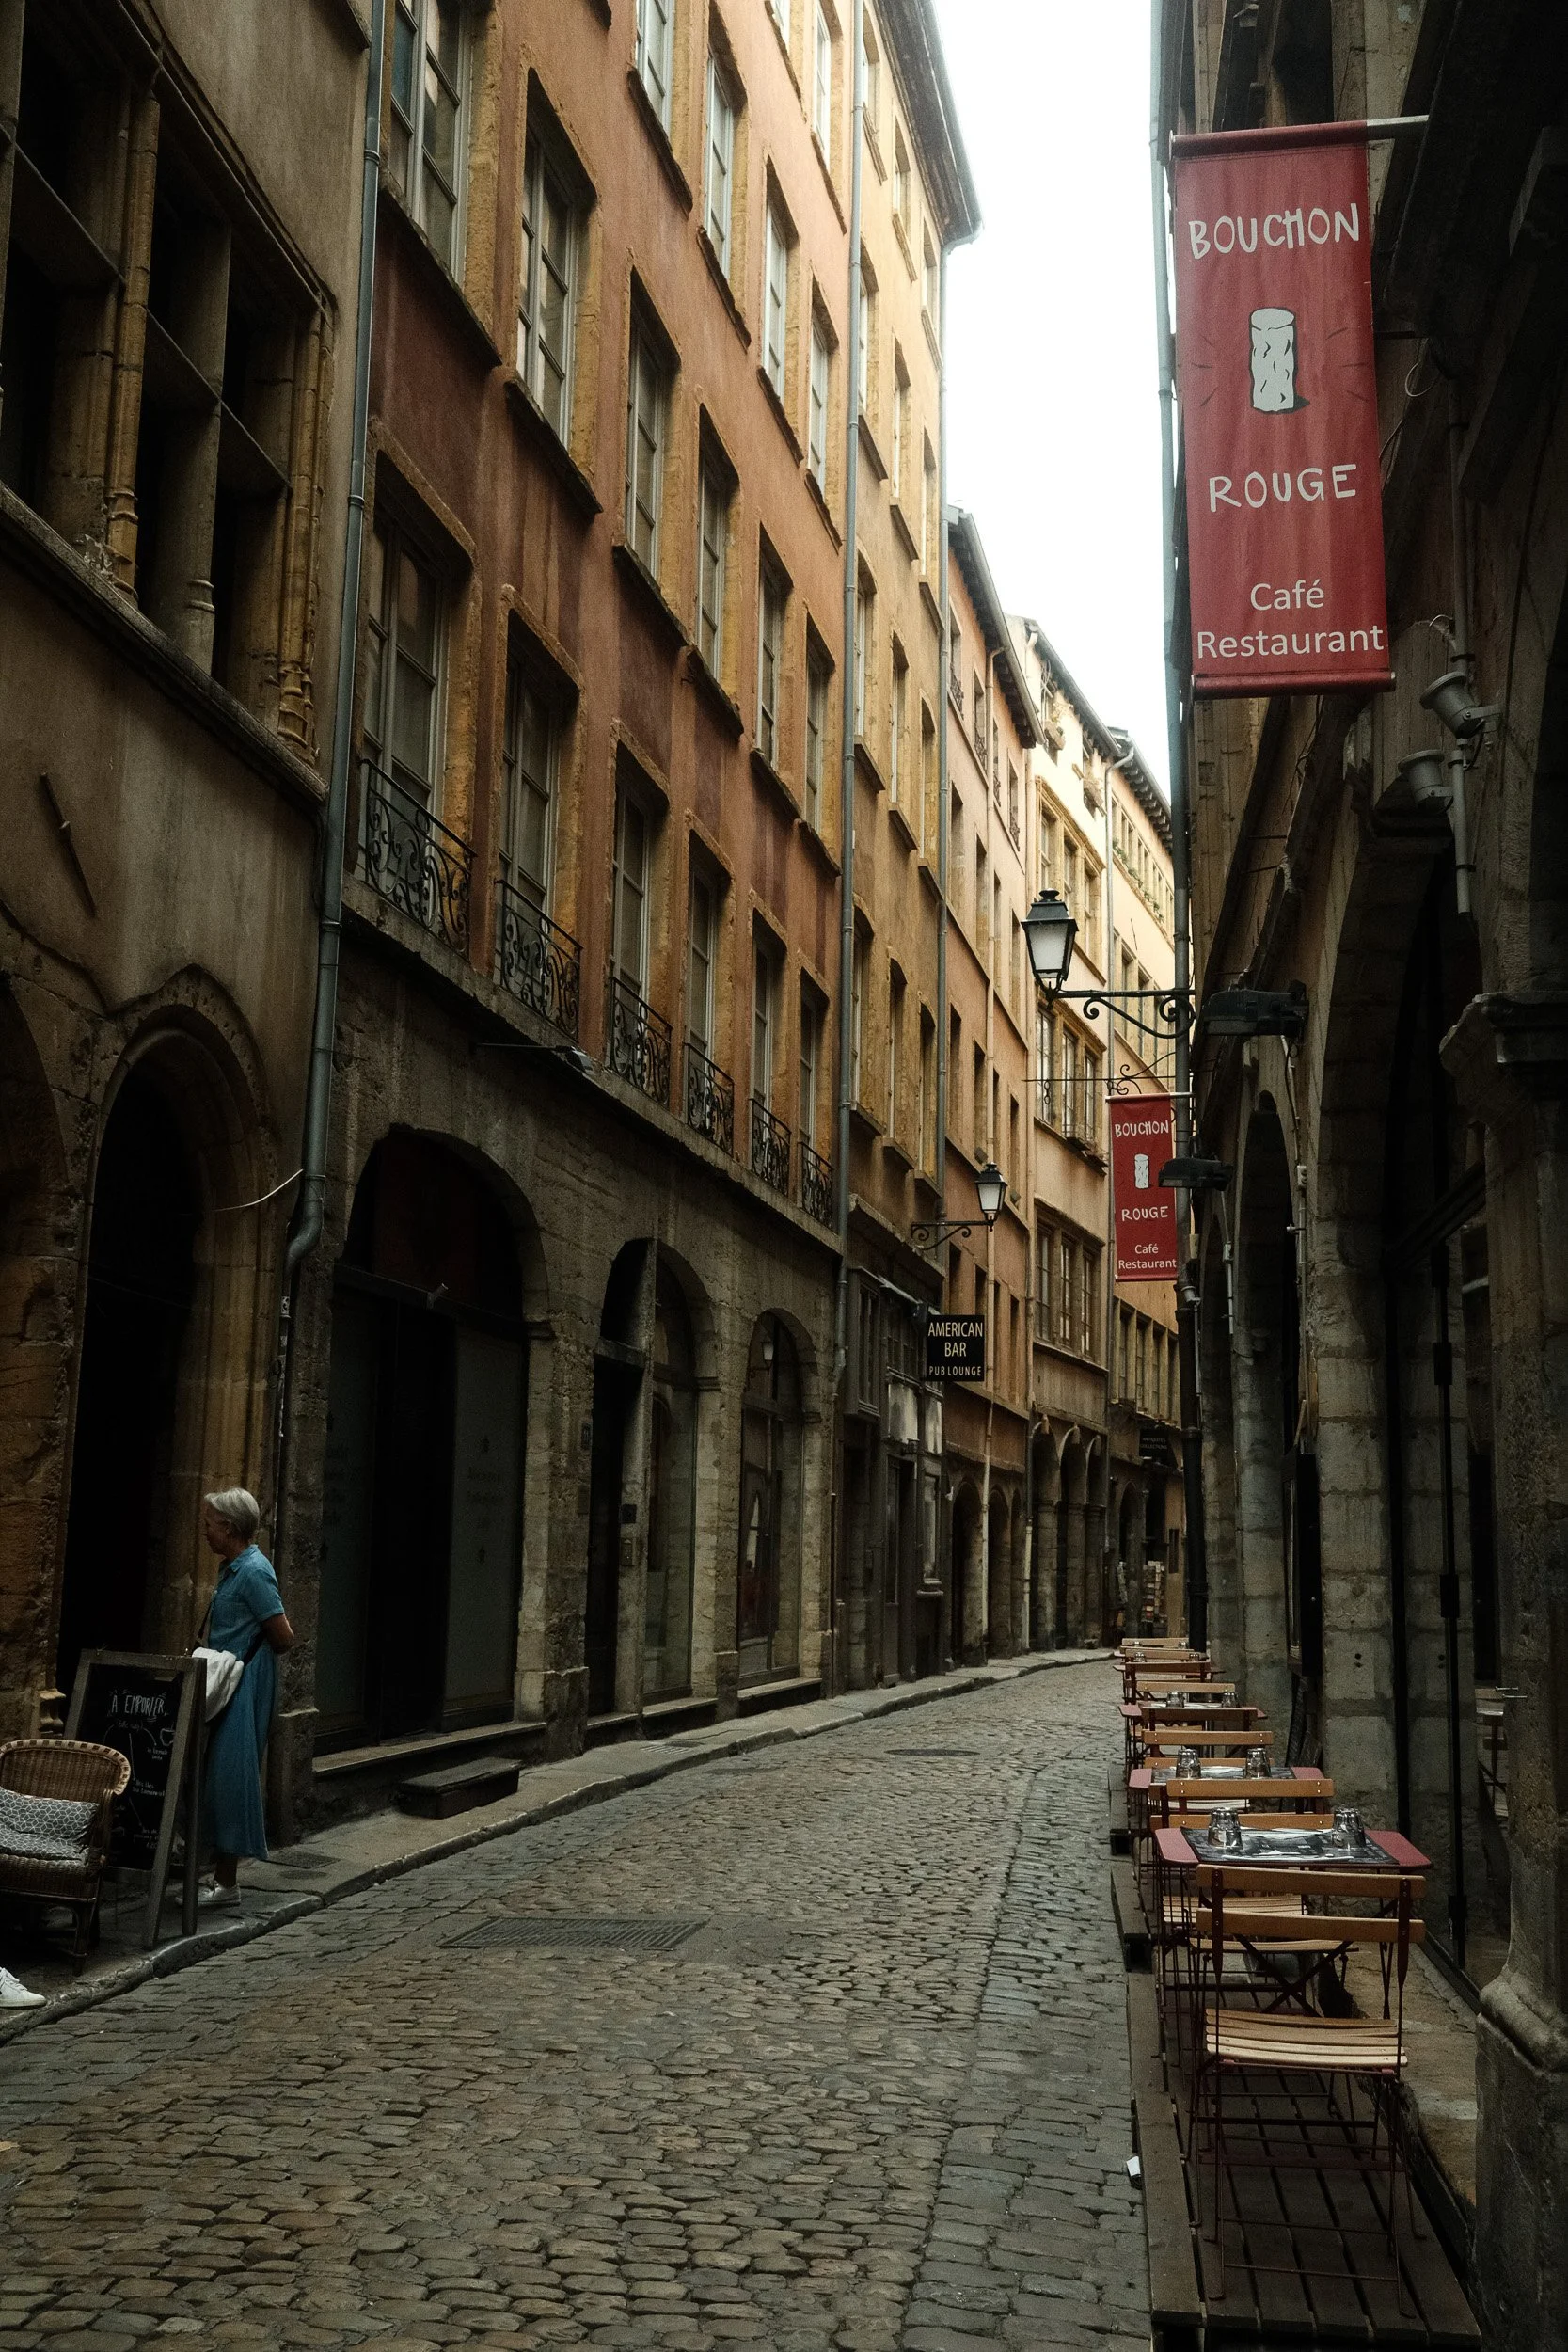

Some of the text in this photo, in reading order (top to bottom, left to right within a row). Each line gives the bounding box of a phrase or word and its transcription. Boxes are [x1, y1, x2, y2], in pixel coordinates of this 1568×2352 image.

[1189, 202, 1360, 260] BOUCHON
[1209, 463, 1357, 513] ROUGE
[1250, 578, 1324, 612] Café
[1196, 625, 1385, 660] Restaurant
[1114, 1120, 1169, 1138] BOUCHON
[1121, 1205, 1169, 1222] ROUGE
[1134, 1243, 1159, 1255] Café
[1118, 1259, 1177, 1270] Restaurant
[927, 1322, 983, 1338] AMERICAN
[944, 1342, 967, 1357] BAR
[928, 1365, 982, 1376] PUB LOUNGE
